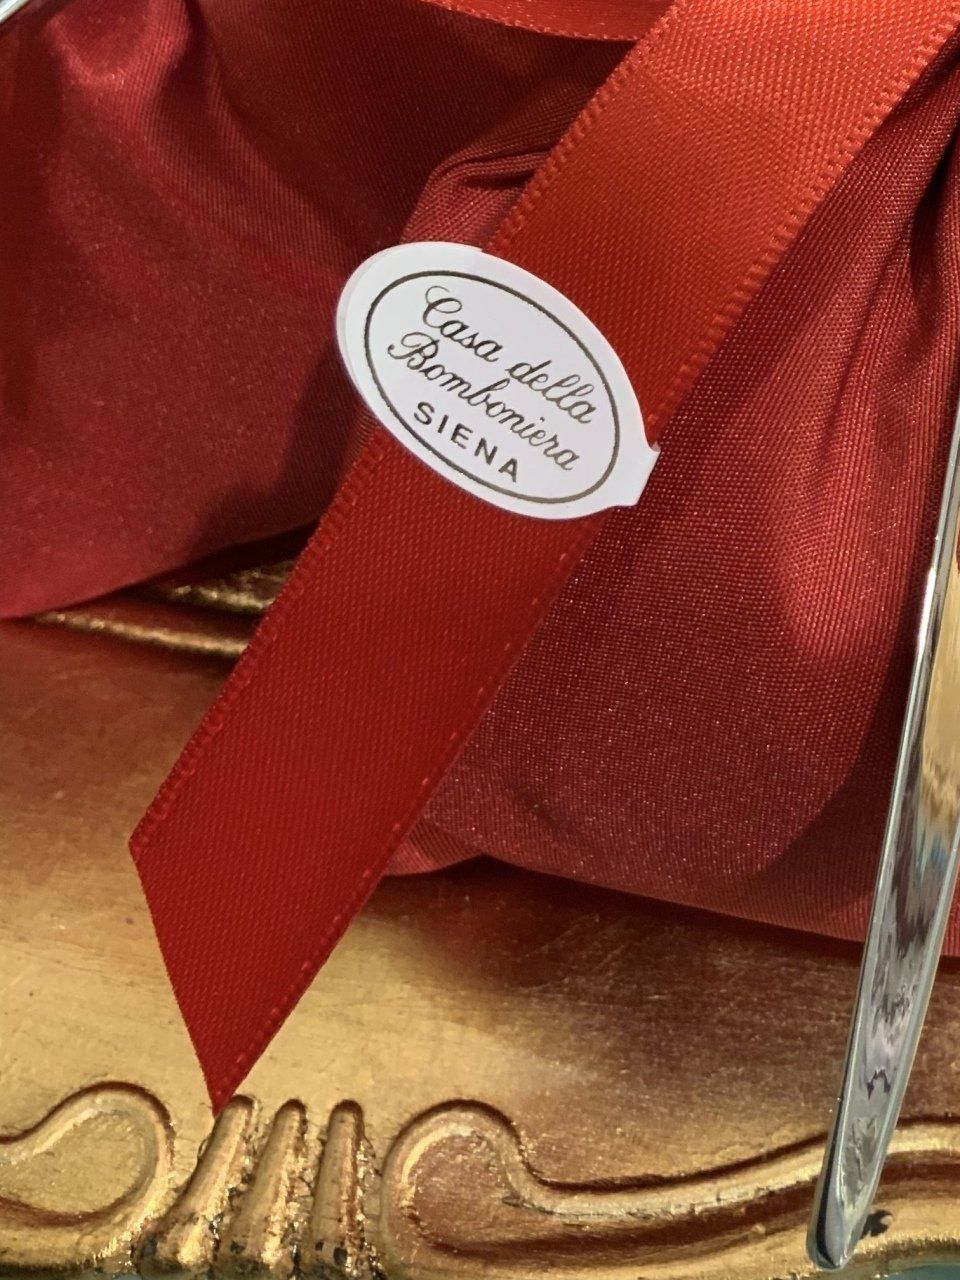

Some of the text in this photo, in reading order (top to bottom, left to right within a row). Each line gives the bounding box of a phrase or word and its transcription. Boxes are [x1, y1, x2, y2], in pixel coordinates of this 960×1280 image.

[387, 331, 580, 471] Bomboniera
[422, 285, 597, 424] Casa della
[413, 401, 519, 483] SIENA
